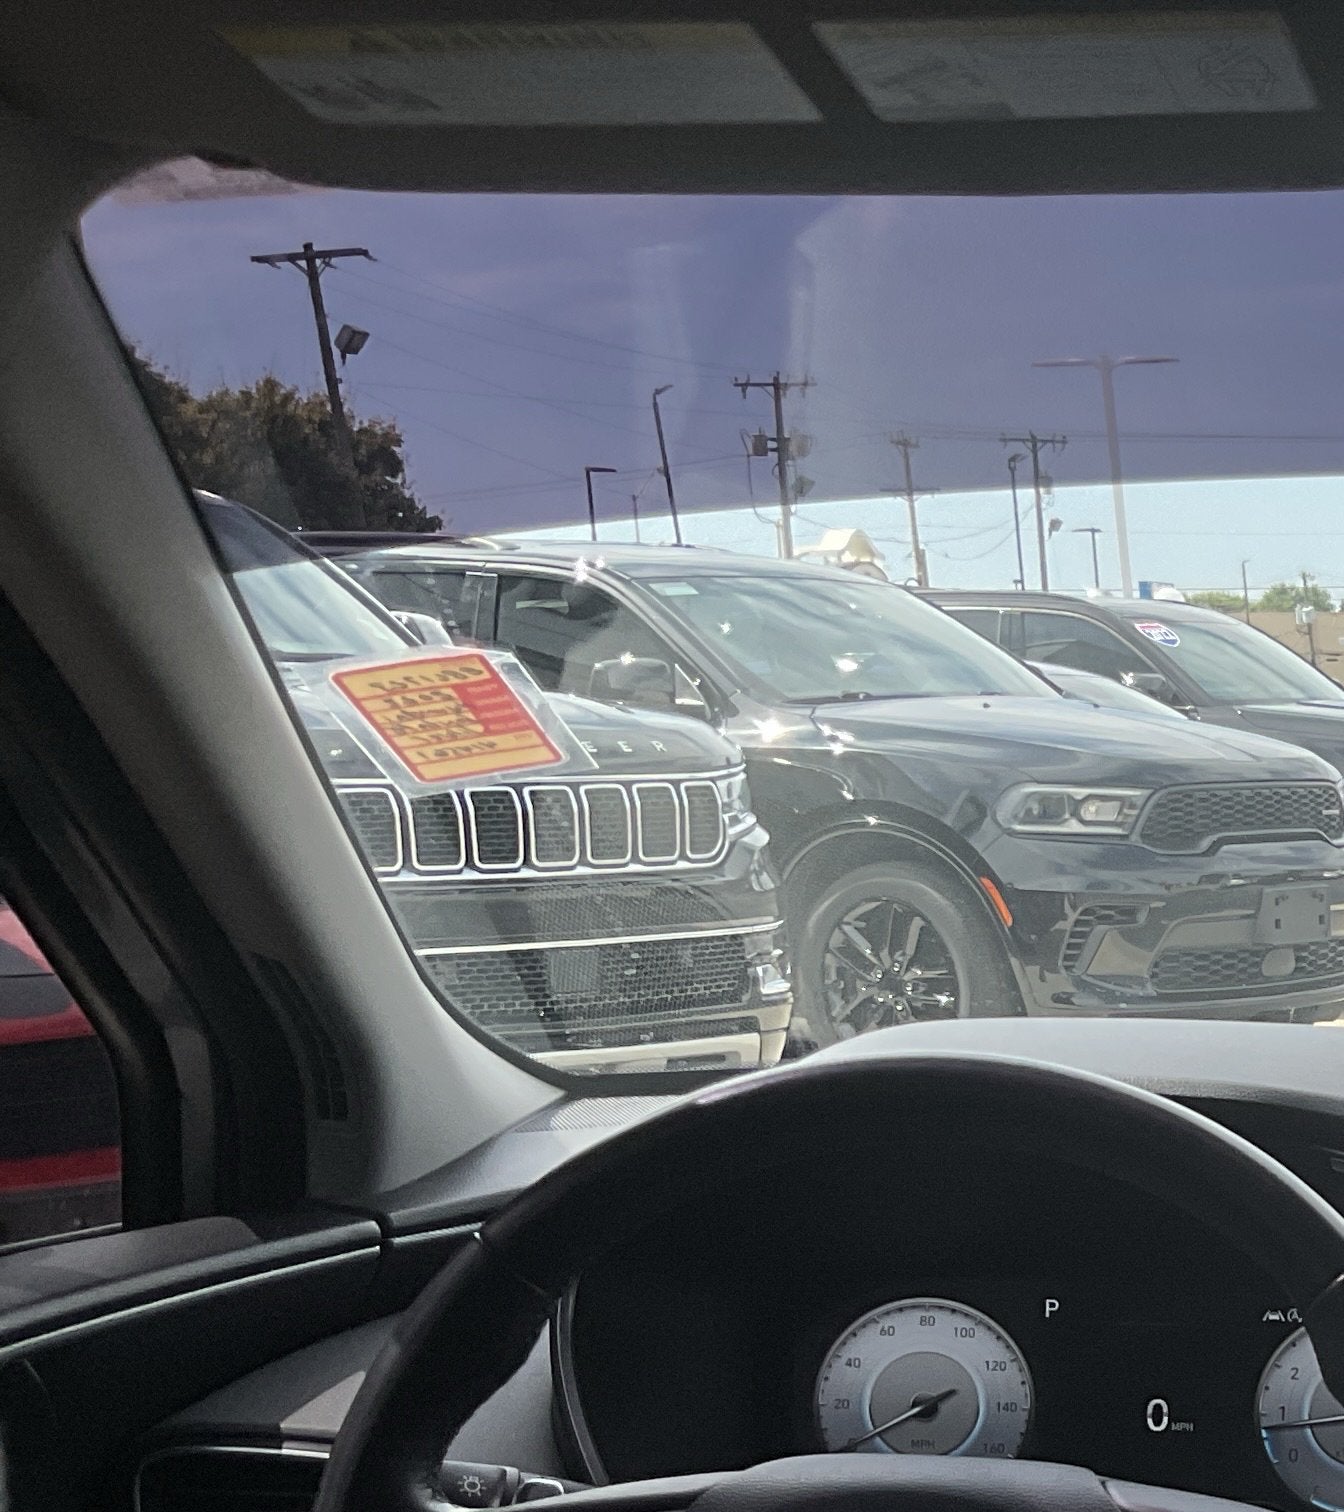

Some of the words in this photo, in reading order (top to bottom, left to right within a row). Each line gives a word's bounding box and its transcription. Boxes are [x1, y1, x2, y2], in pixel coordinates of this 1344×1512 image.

[1044, 1299, 1060, 1318] P
[919, 1315, 936, 1326] 80
[879, 1325, 895, 1337] 60
[953, 1327, 976, 1338] 100
[844, 1357, 861, 1369] 40
[985, 1360, 1007, 1372] 120
[1290, 1367, 1299, 1381] 2
[834, 1399, 850, 1410] 20
[997, 1402, 1018, 1413] 140
[1146, 1398, 1169, 1431] 0
[1171, 1422, 1194, 1431] MPH
[983, 1443, 1005, 1454] 160
[1288, 1449, 1298, 1462] 0
